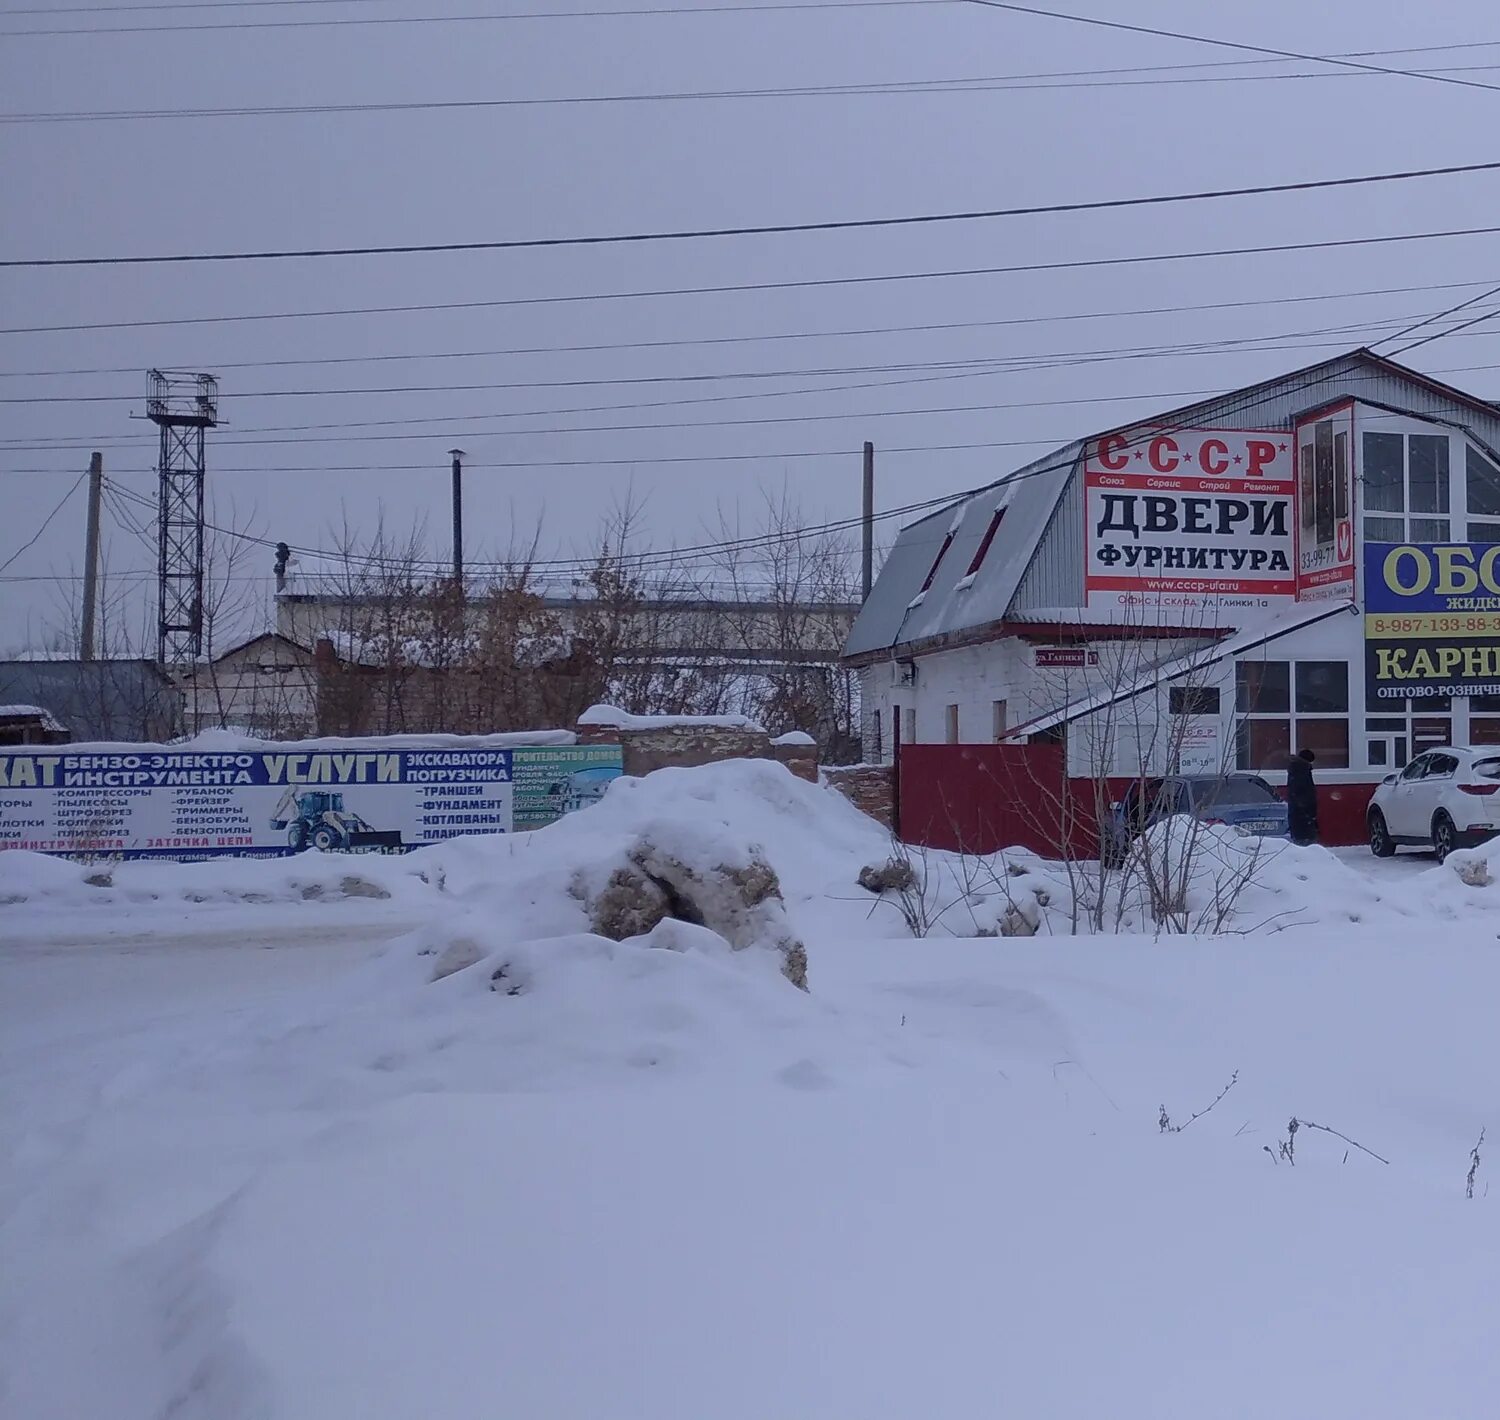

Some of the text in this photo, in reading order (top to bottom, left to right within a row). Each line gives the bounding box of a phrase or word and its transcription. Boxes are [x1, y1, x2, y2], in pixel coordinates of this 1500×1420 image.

[1099, 475, 1280, 493] Союз Сервис Строй Ремонт
[1097, 494, 1289, 539] ДВЕРИ
[1096, 543, 1290, 571] ФУРНИТУРА
[1302, 545, 1336, 569] 33-99-77
[1118, 595, 1151, 606] Офис
[1218, 598, 1254, 607] Глинки
[64, 755, 254, 769] БЕНЗО-ЭЛЕКТРО
[406, 753, 506, 767] ЭКСКАВАТОРА
[586, 750, 622, 761] ДОМОВ
[262, 754, 400, 784] УСЛУГИ
[406, 768, 509, 782] ПОГРУЗЧИКА
[64, 770, 253, 787] ИНСТРУМЕНТА
[0, 819, 45, 828] ЛОТКИ
[147, 837, 209, 848] ЗАТОЧКА
[217, 836, 253, 846] ЦЕПИ
